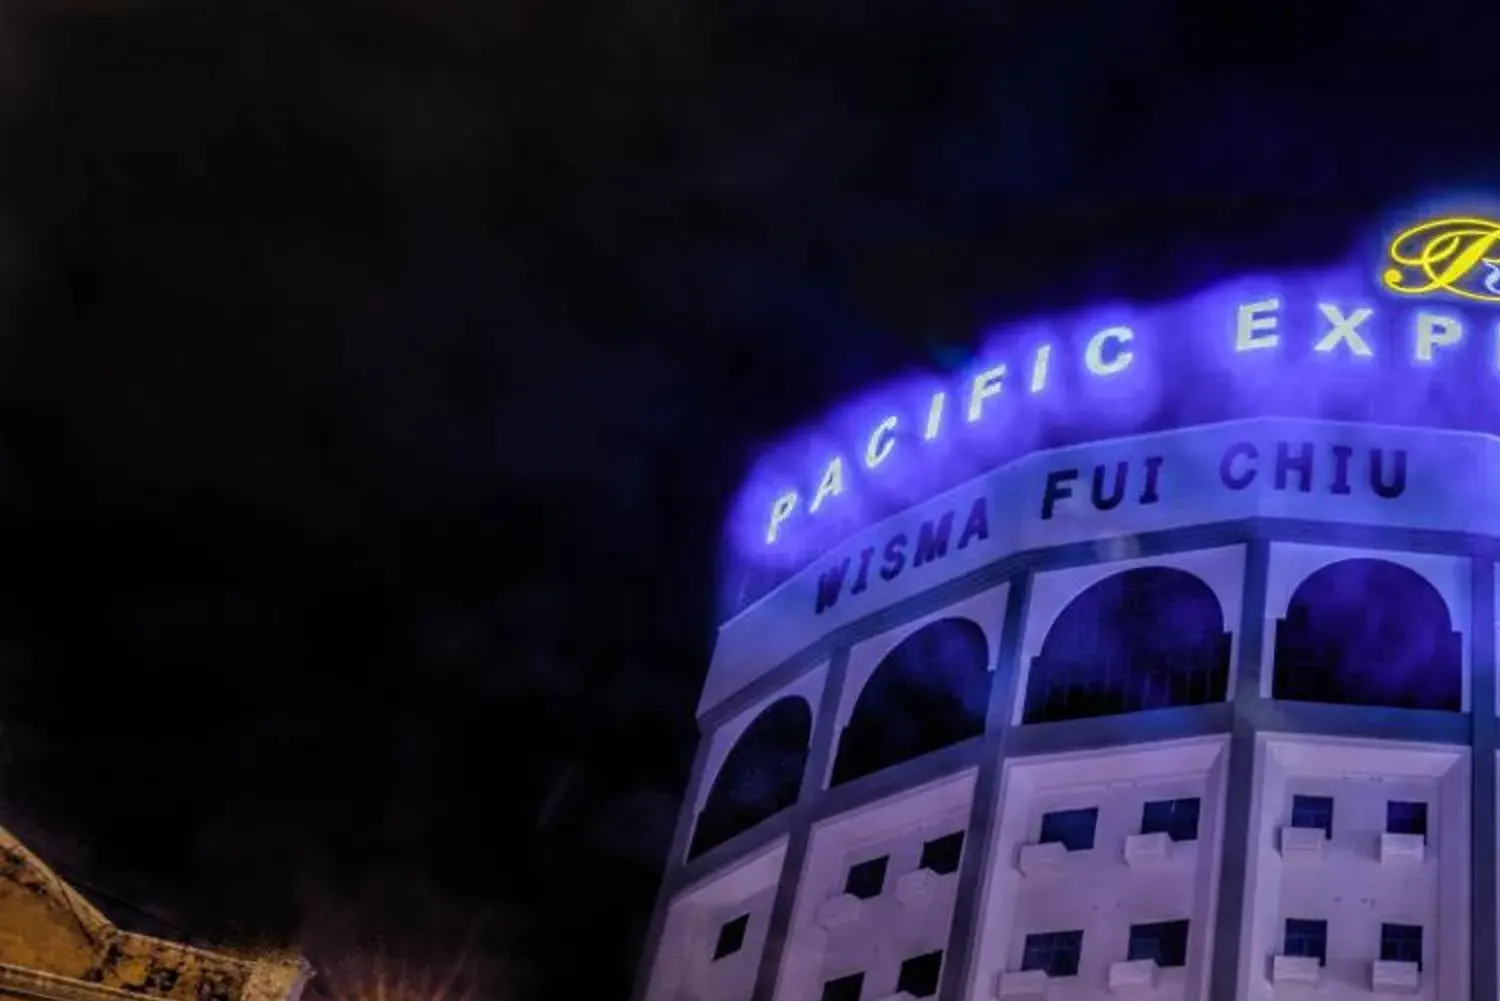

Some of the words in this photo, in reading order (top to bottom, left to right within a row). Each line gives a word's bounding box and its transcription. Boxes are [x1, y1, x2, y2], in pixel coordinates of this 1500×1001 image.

[764, 326, 1135, 545] PACIFIC
[814, 497, 990, 614] WISMA
[1041, 456, 1164, 520] FUI
[1219, 441, 1408, 499] CHIU
